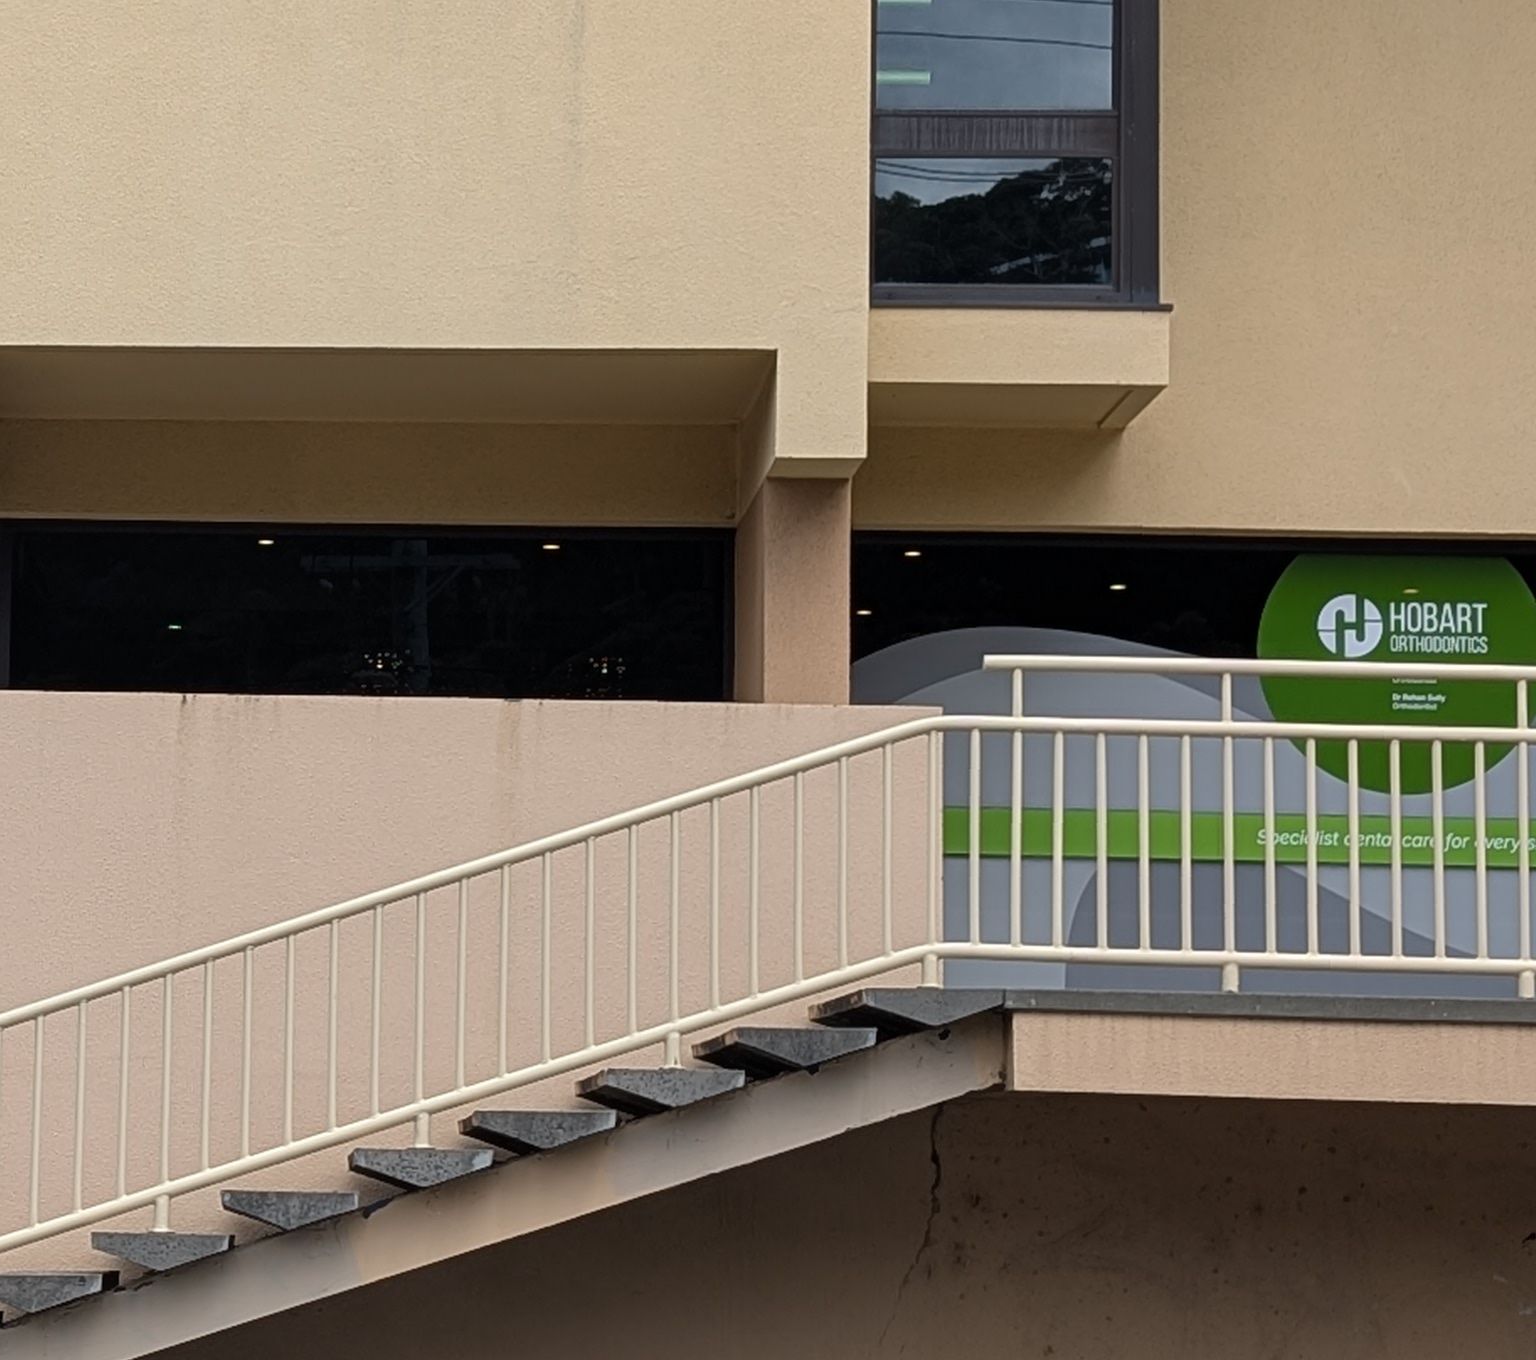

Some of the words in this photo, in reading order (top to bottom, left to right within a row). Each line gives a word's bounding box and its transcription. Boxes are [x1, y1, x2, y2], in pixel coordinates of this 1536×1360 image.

[1389, 602, 1489, 634] HOBART
[1389, 635, 1489, 655] ORTHODONTICS
[1442, 832, 1472, 853] for
[1474, 836, 1522, 854] very
